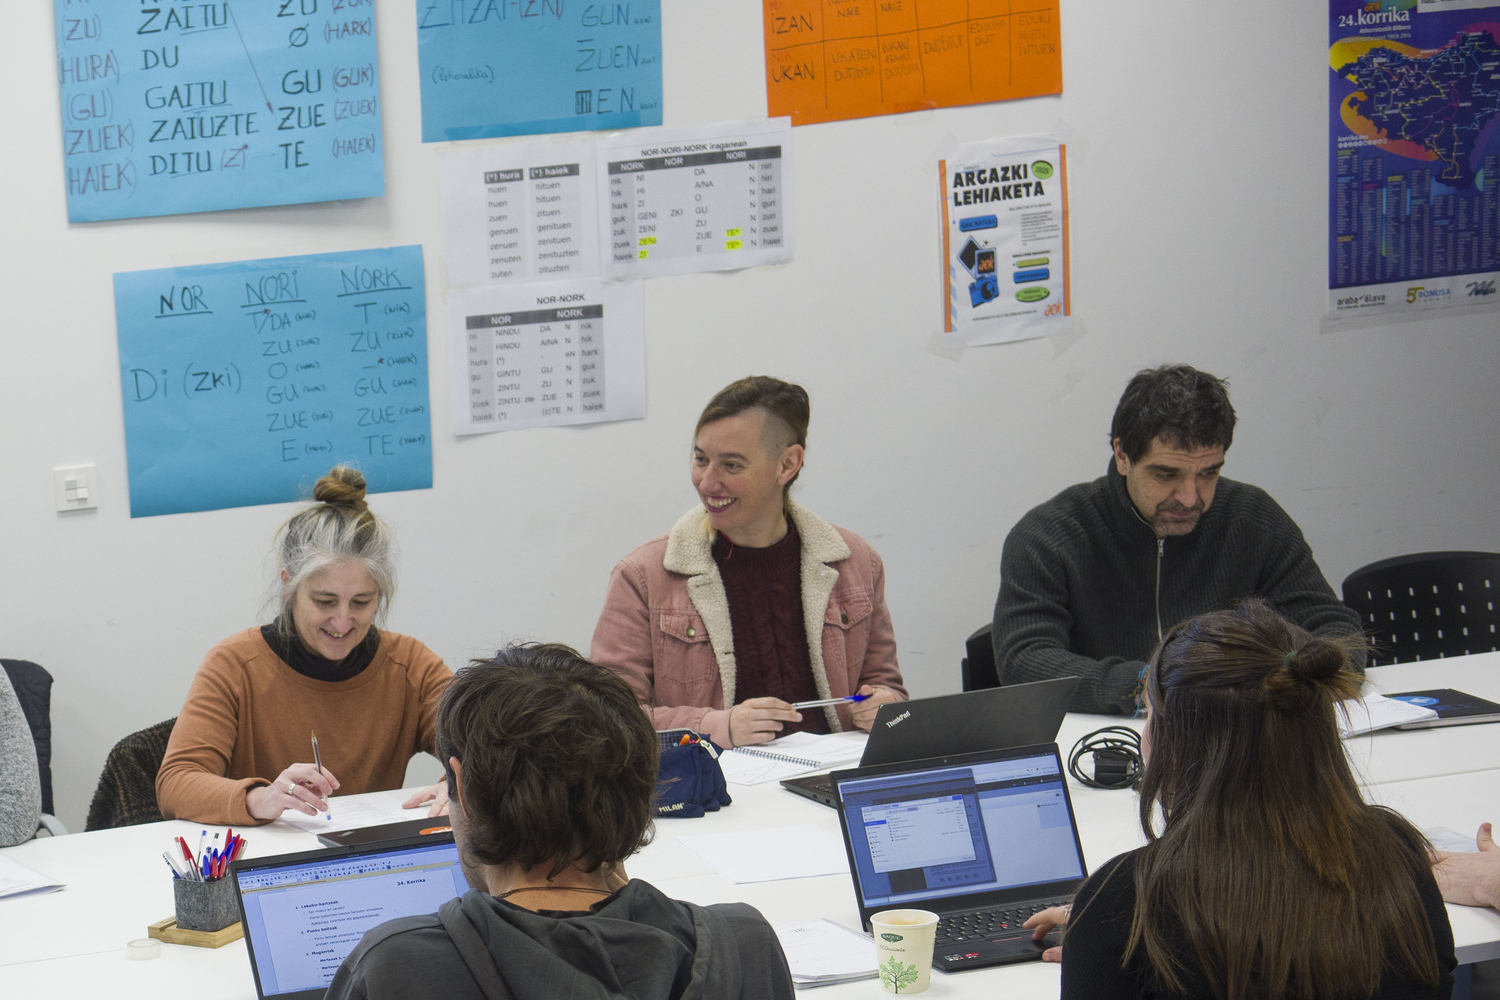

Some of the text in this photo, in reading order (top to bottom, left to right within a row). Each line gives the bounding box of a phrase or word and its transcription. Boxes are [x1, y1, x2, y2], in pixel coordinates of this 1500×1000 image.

[137, 3, 228, 34] ZAITU
[140, 46, 179, 70] DU
[145, 80, 227, 109] GAITU
[282, 69, 321, 94] GU
[277, 104, 326, 130] ZUE
[149, 150, 212, 176] DITU
[279, 140, 309, 169] TE
[620, 162, 644, 171] NORK
[665, 157, 683, 166] NOR
[726, 151, 747, 160] NORI
[953, 163, 1028, 188] ARGAZKI
[954, 181, 1045, 206] LEHIAKETA
[160, 284, 209, 314] NOR
[340, 265, 402, 294] NORK
[536, 293, 586, 305] NOR-NORK
[491, 315, 512, 325] NOR
[556, 308, 584, 318] NORK
[262, 339, 293, 356] ZU
[350, 331, 382, 352] ZU
[266, 384, 299, 404] GU
[354, 377, 387, 397] GU
[266, 406, 397, 432] ZUE ZUE
[282, 439, 299, 462] E
[364, 434, 395, 456] TE
